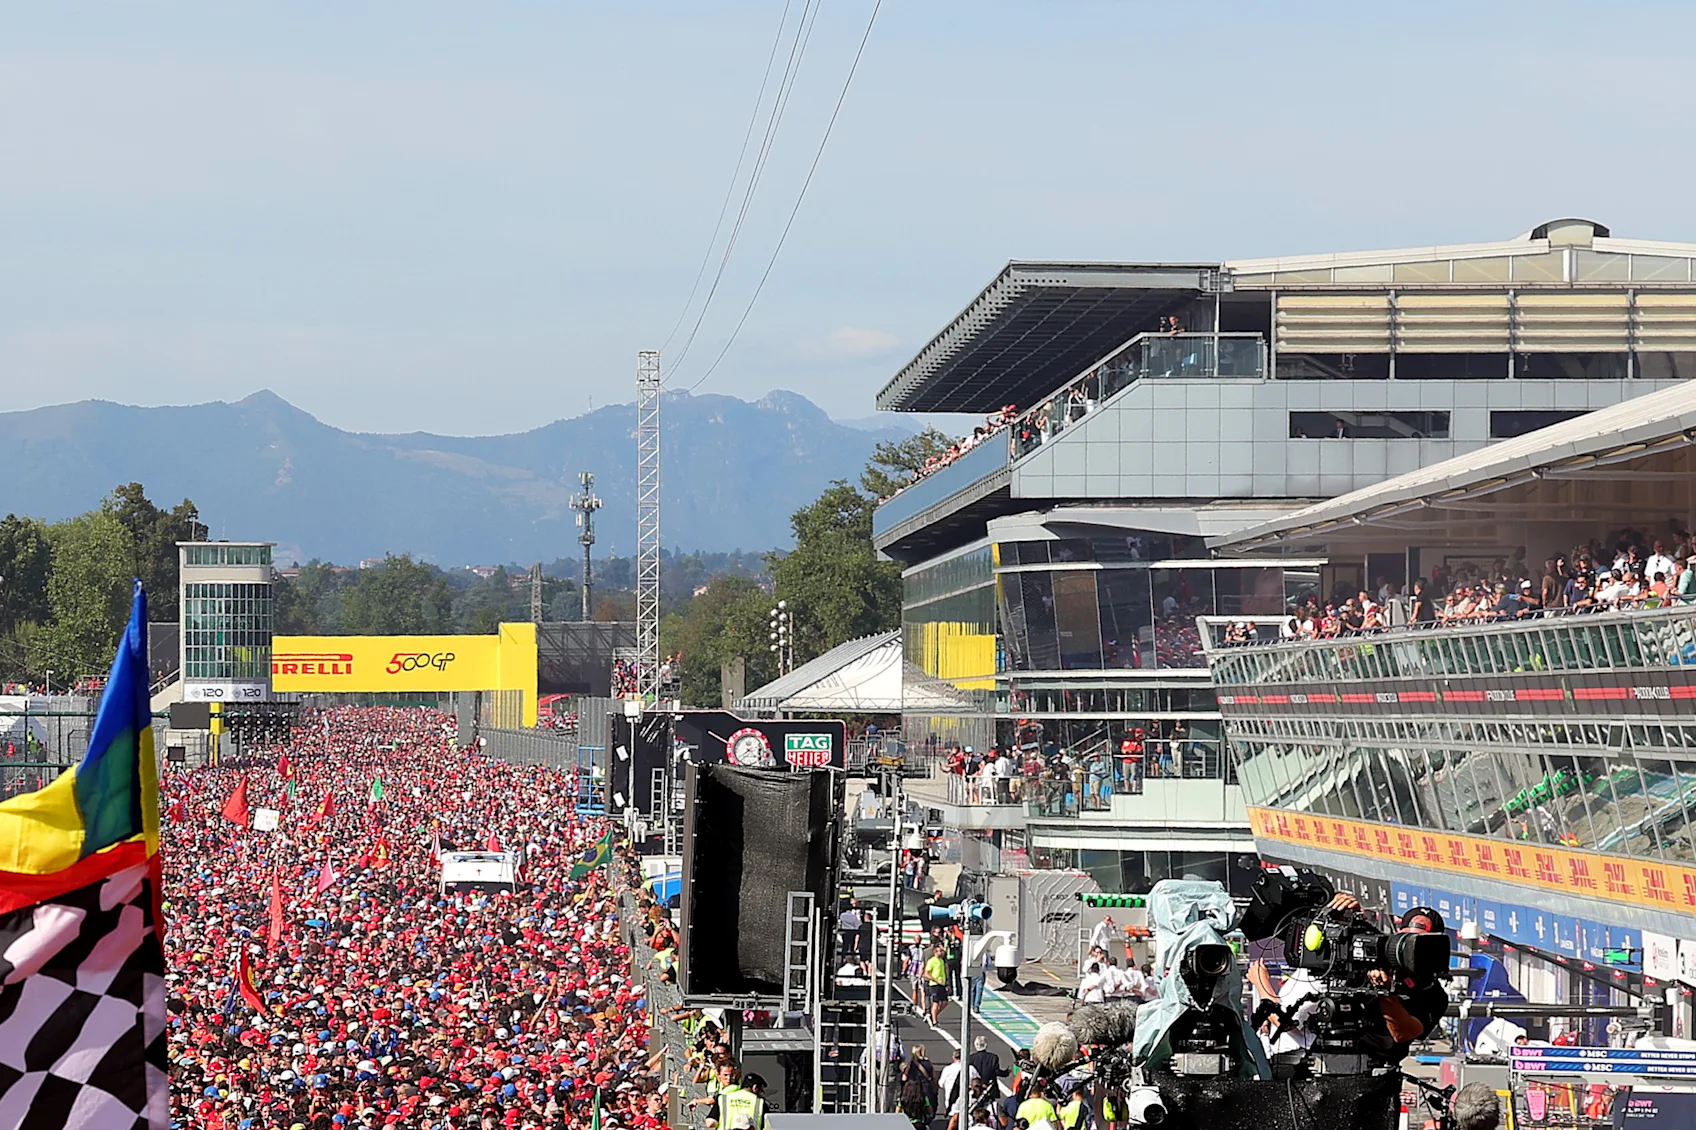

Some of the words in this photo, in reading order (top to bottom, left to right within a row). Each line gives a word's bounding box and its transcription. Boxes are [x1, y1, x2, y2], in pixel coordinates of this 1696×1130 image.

[202, 688, 224, 698] 120
[242, 688, 261, 698] 120
[788, 736, 828, 749] TAG
[1521, 1049, 1543, 1057] BWT
[1523, 1062, 1546, 1070] BWT
[1591, 1064, 1613, 1072] MSC
[1634, 1100, 1653, 1108] BWT
